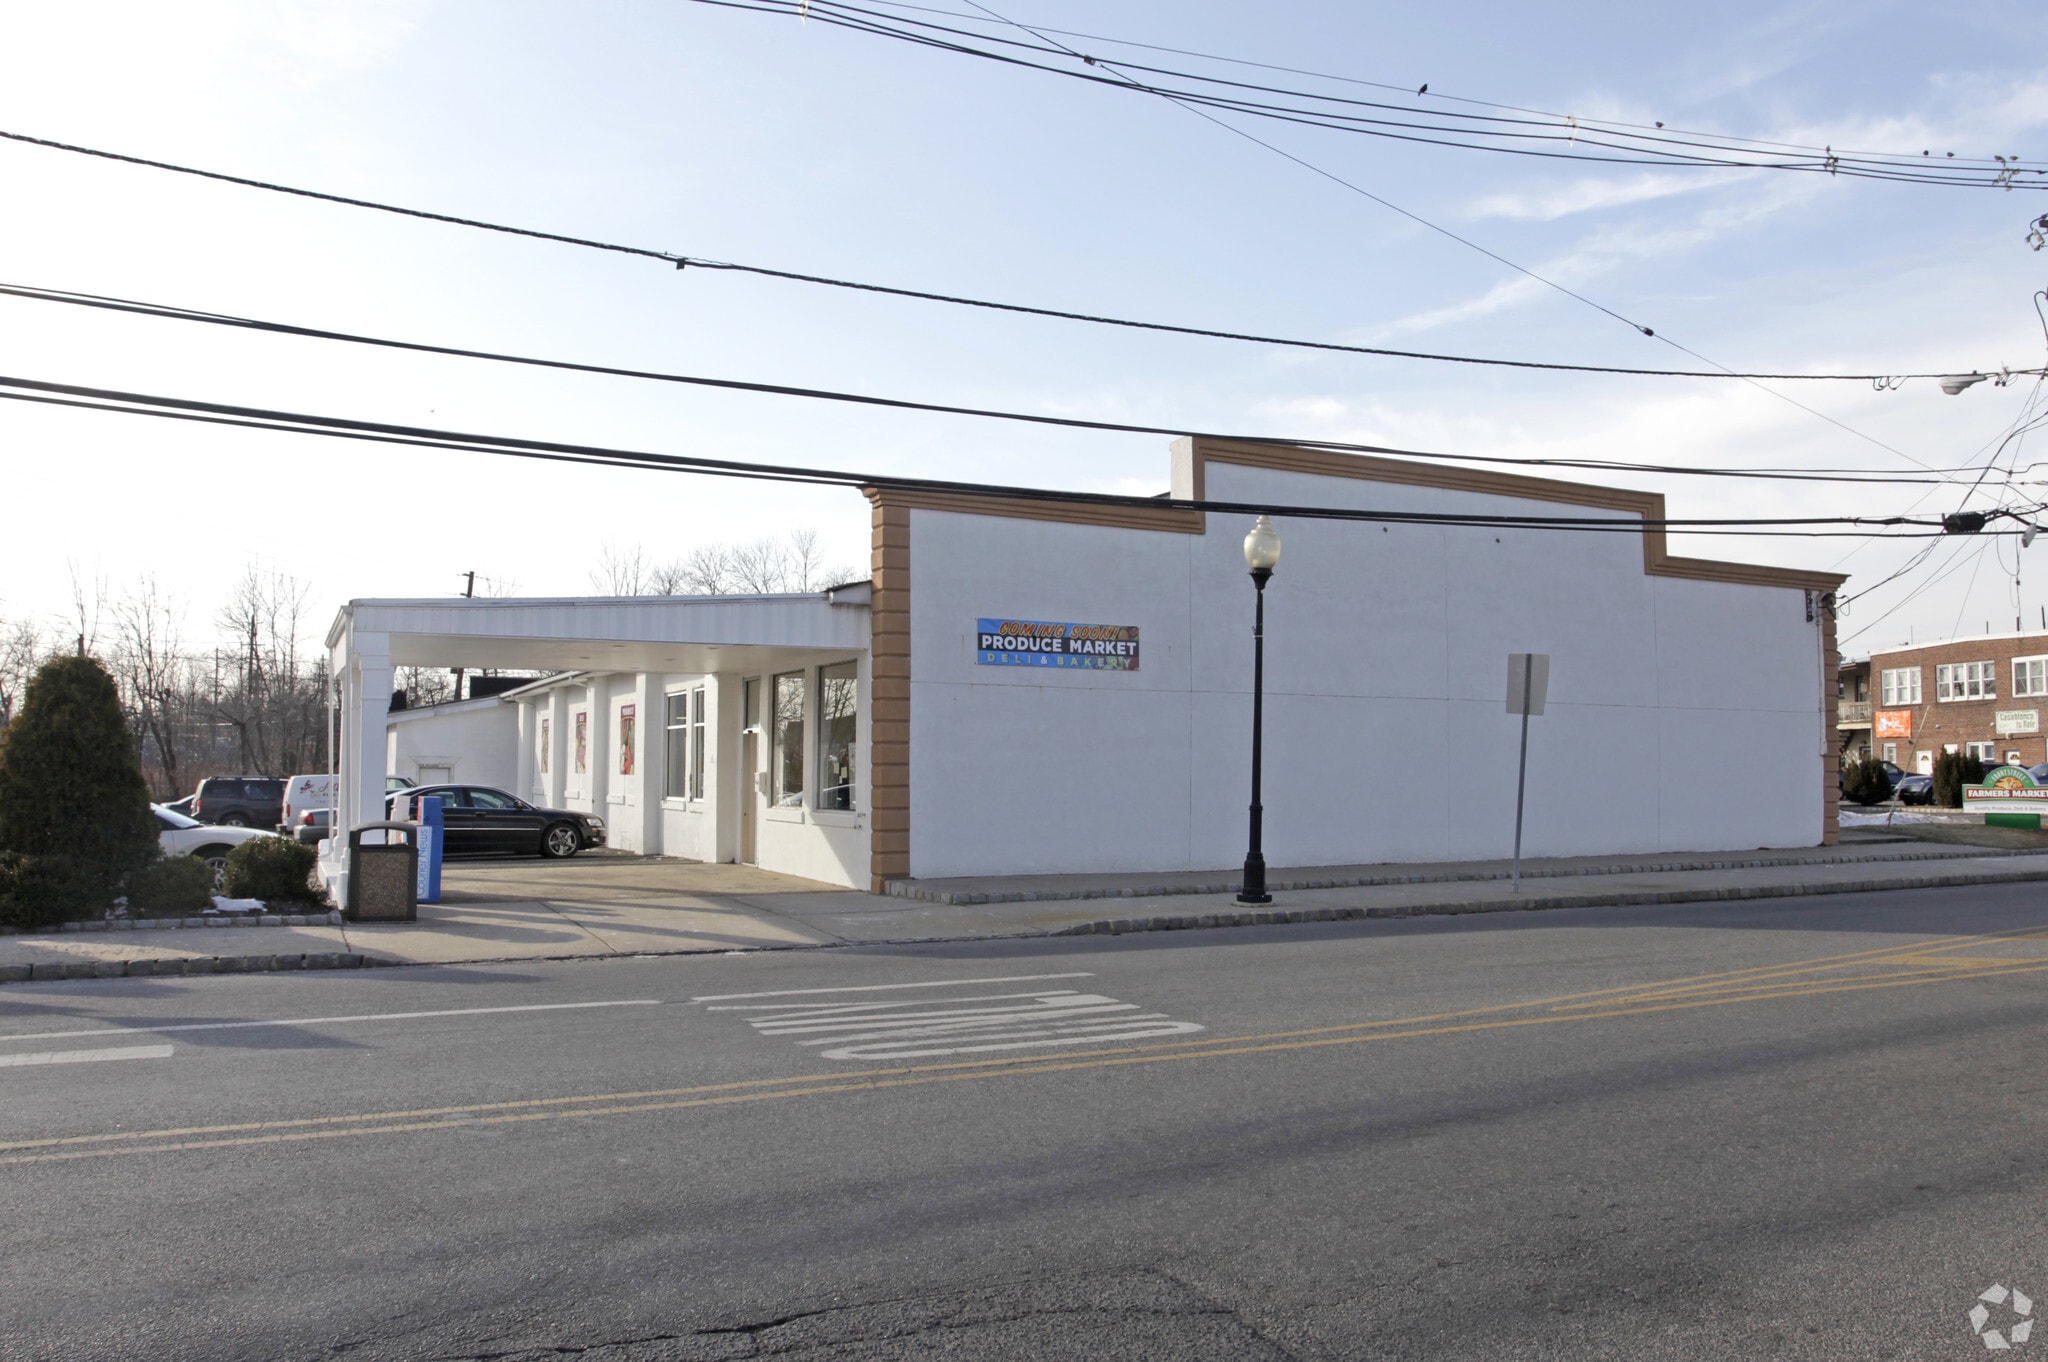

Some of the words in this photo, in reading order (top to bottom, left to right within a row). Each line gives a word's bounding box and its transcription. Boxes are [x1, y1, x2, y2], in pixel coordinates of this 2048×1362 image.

[999, 621, 1066, 638] COMING
[1070, 624, 1120, 640] SOON!
[982, 635, 1062, 652] PRODUCE
[1070, 640, 1136, 655] MARKET
[987, 653, 1032, 664] DELI
[1040, 656, 1048, 665] &
[1057, 656, 1131, 668] BAKERY
[1968, 789, 2010, 797] FARMERS
[418, 829, 429, 857] News
[417, 860, 427, 896] Courier
